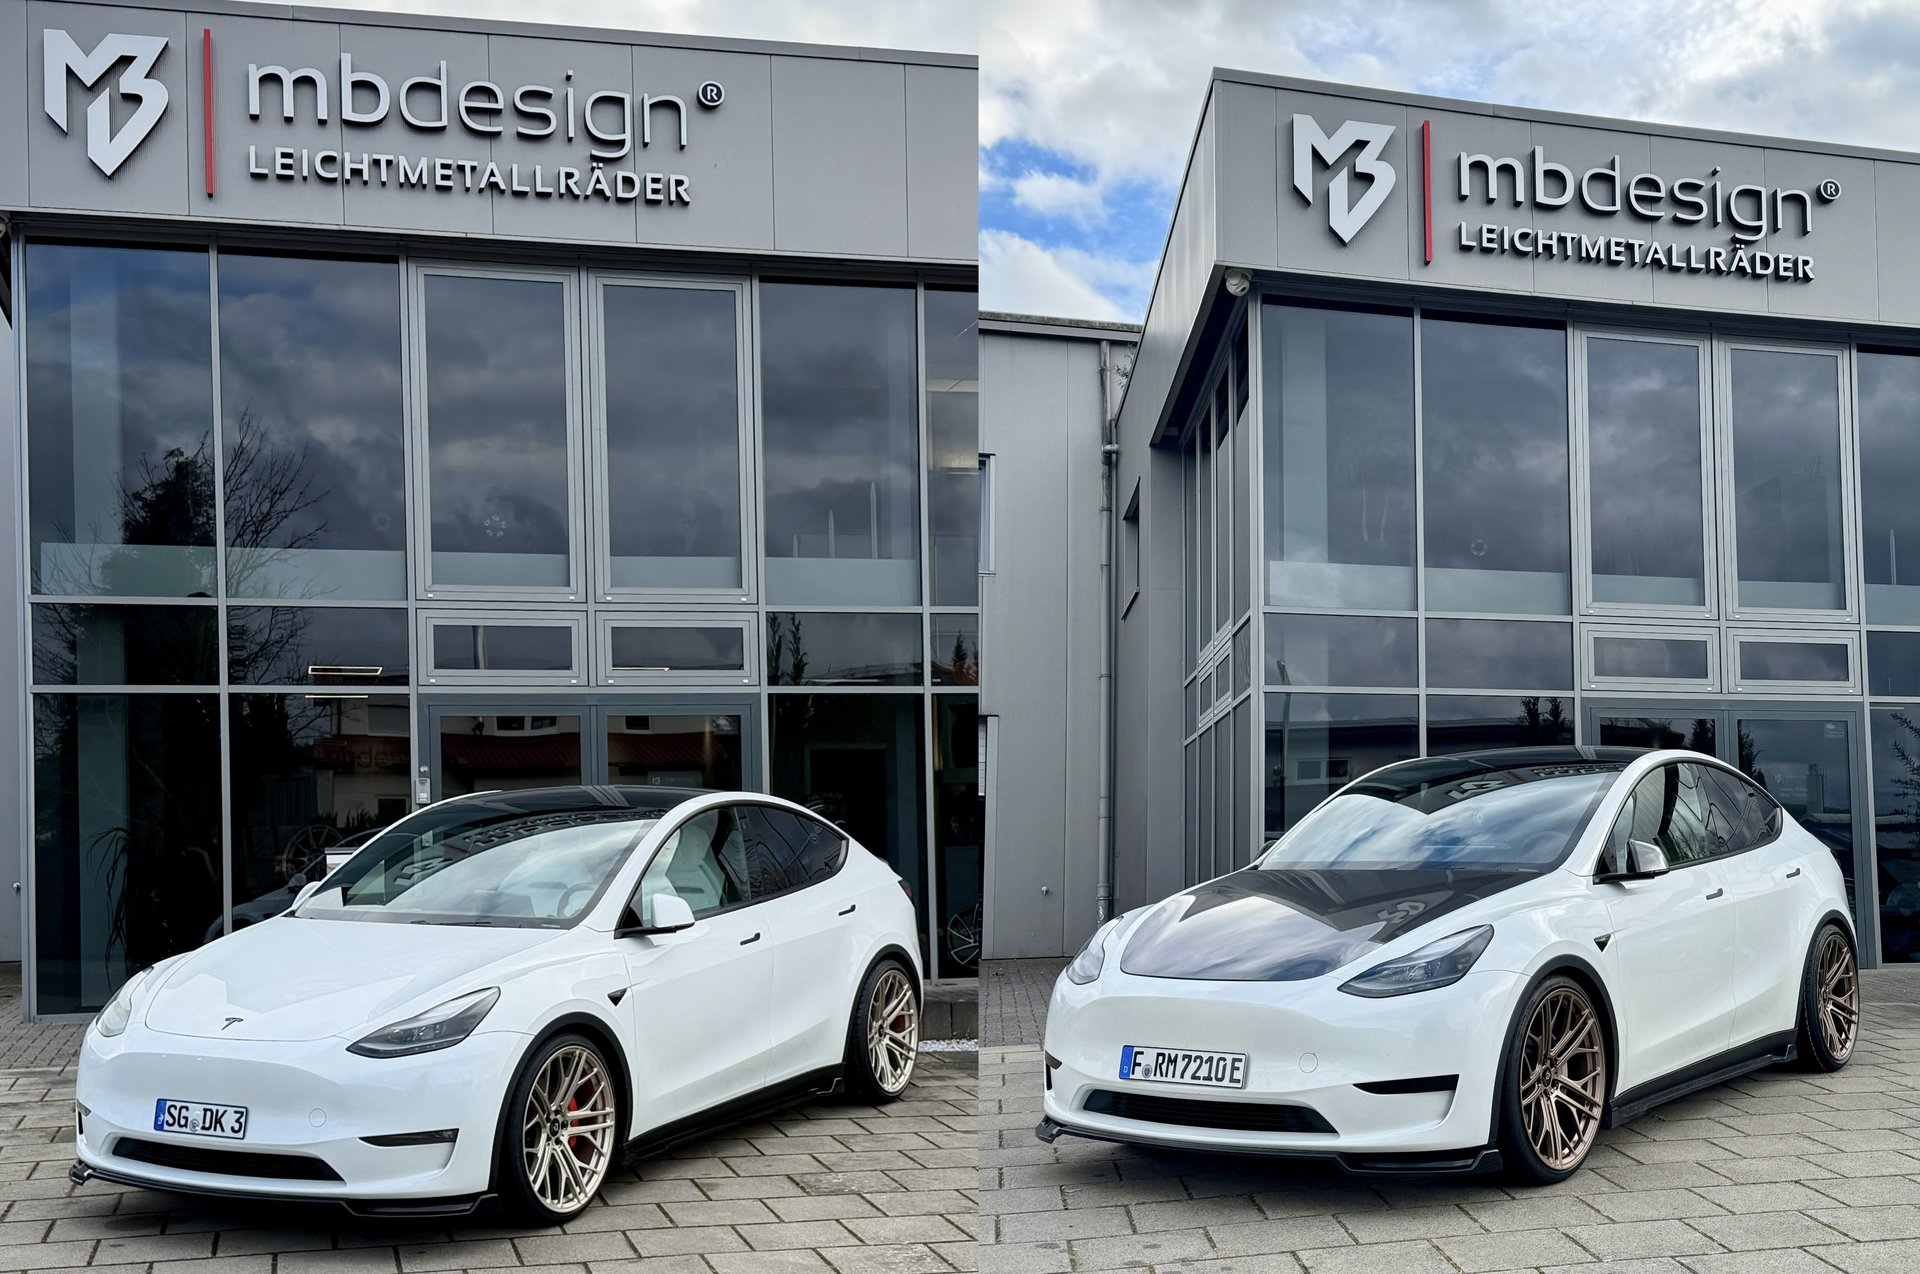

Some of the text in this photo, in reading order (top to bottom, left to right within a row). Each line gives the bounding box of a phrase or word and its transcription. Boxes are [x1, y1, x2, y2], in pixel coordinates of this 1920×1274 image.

[249, 145, 692, 206] LEICHTMETALLRÄDER
[1459, 221, 1815, 281] LEICHTMETALLRÄDER
[1132, 1051, 1144, 1075] F
[166, 1104, 189, 1128] SG
[201, 1108, 227, 1132] DK
[231, 1110, 244, 1133] 3
